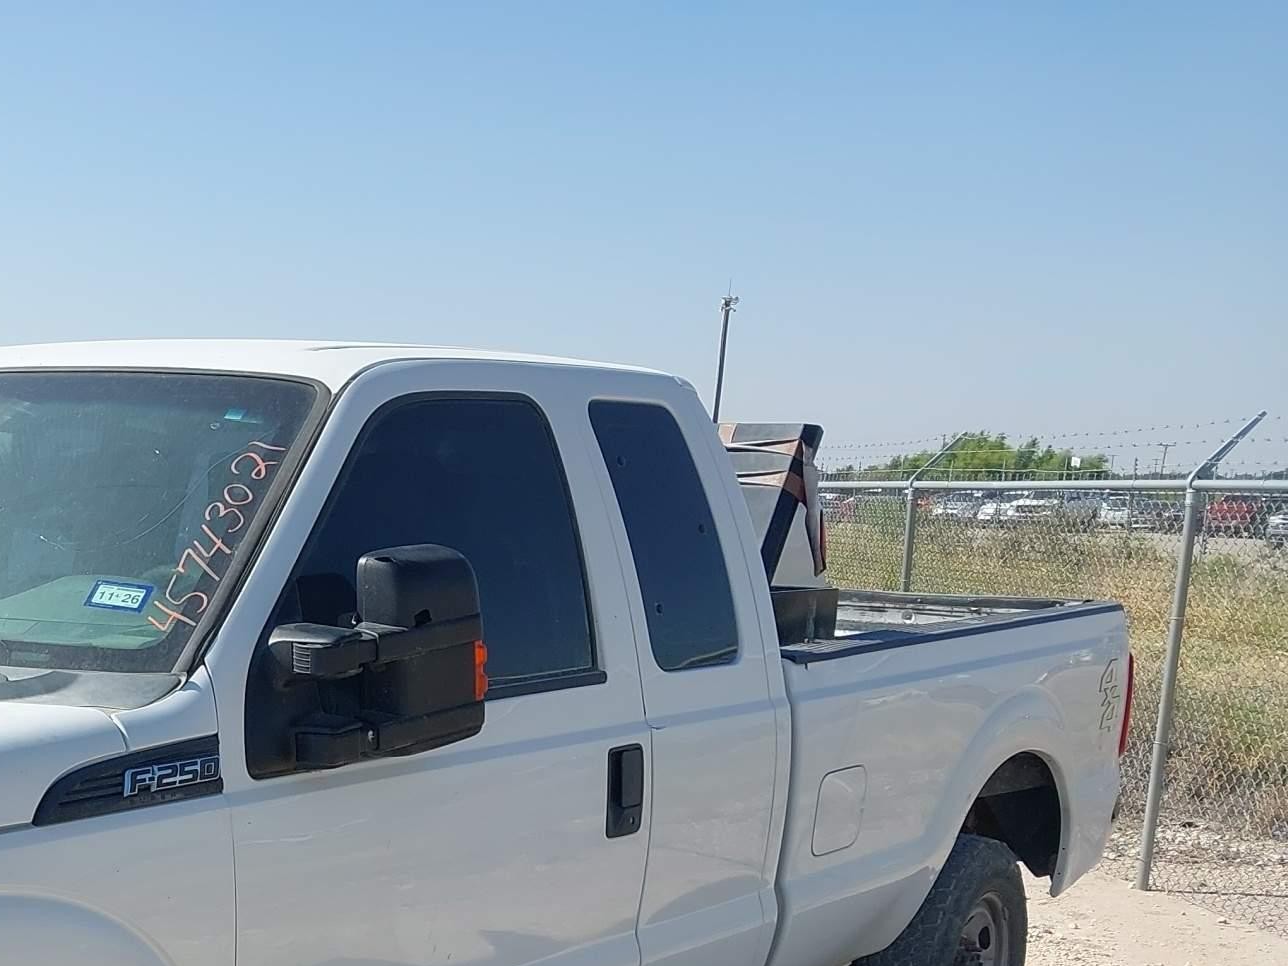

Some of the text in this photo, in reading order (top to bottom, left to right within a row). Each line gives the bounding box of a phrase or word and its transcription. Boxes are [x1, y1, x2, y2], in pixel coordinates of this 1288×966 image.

[148, 441, 288, 632] 45743021
[98, 591, 141, 605] 11 26
[123, 755, 221, 797] F-250
